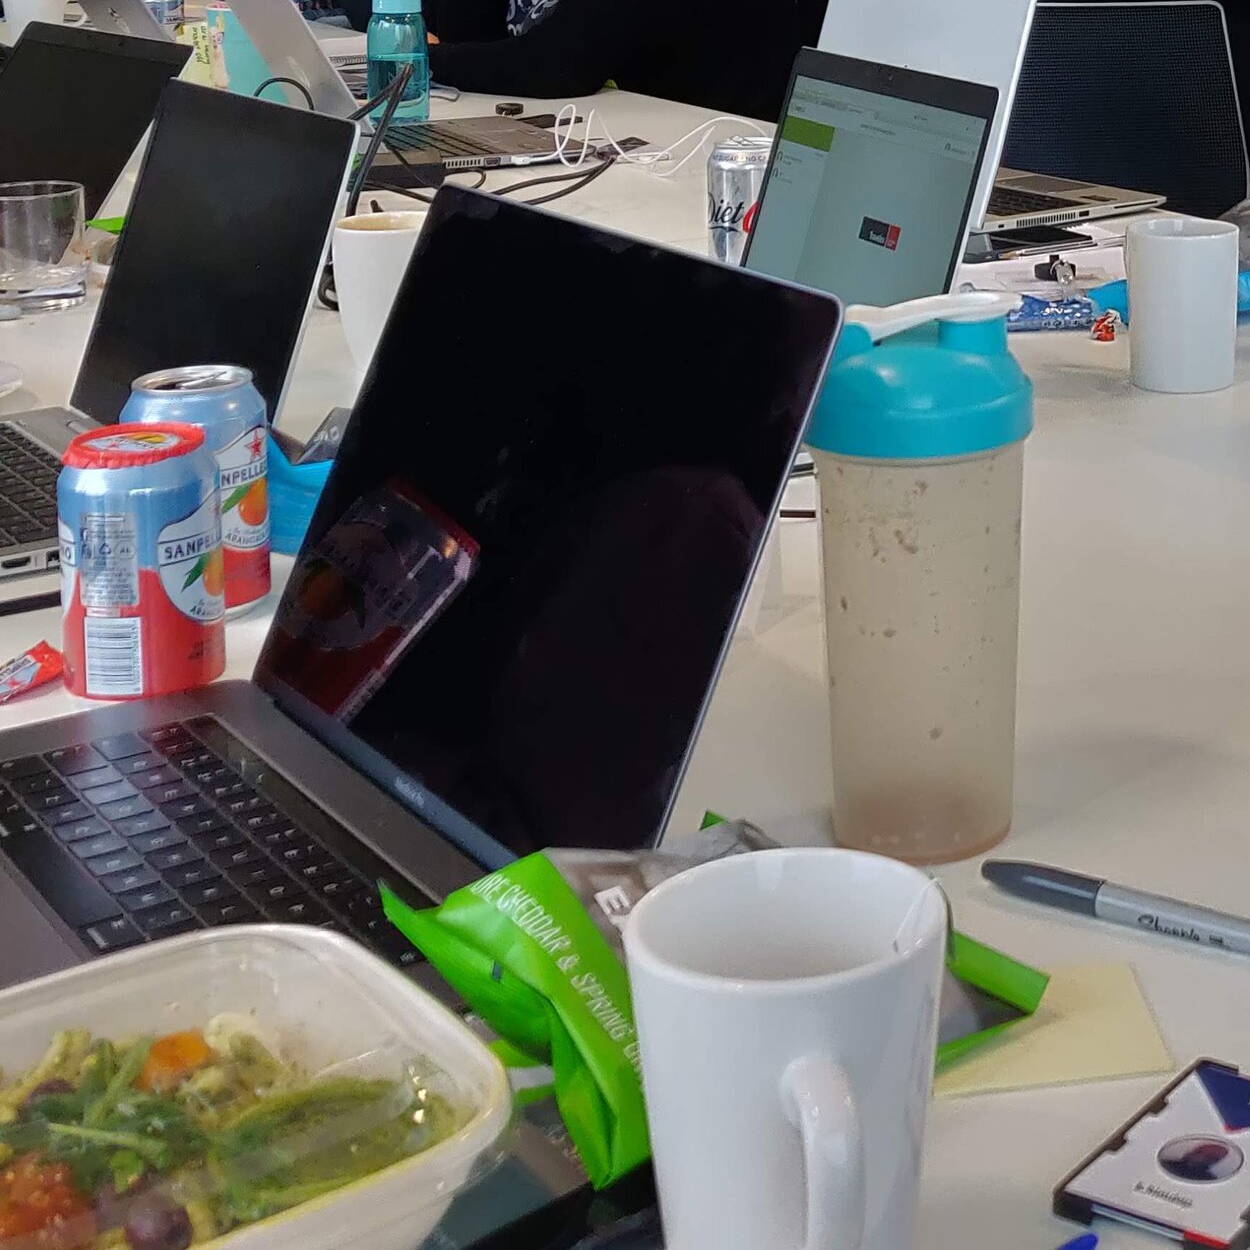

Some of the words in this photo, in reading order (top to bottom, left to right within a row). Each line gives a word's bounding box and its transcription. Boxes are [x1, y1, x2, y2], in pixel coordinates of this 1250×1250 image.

[496, 883, 572, 955] CHEDDAR
[556, 953, 580, 975] &
[570, 972, 635, 1042] SPRING
